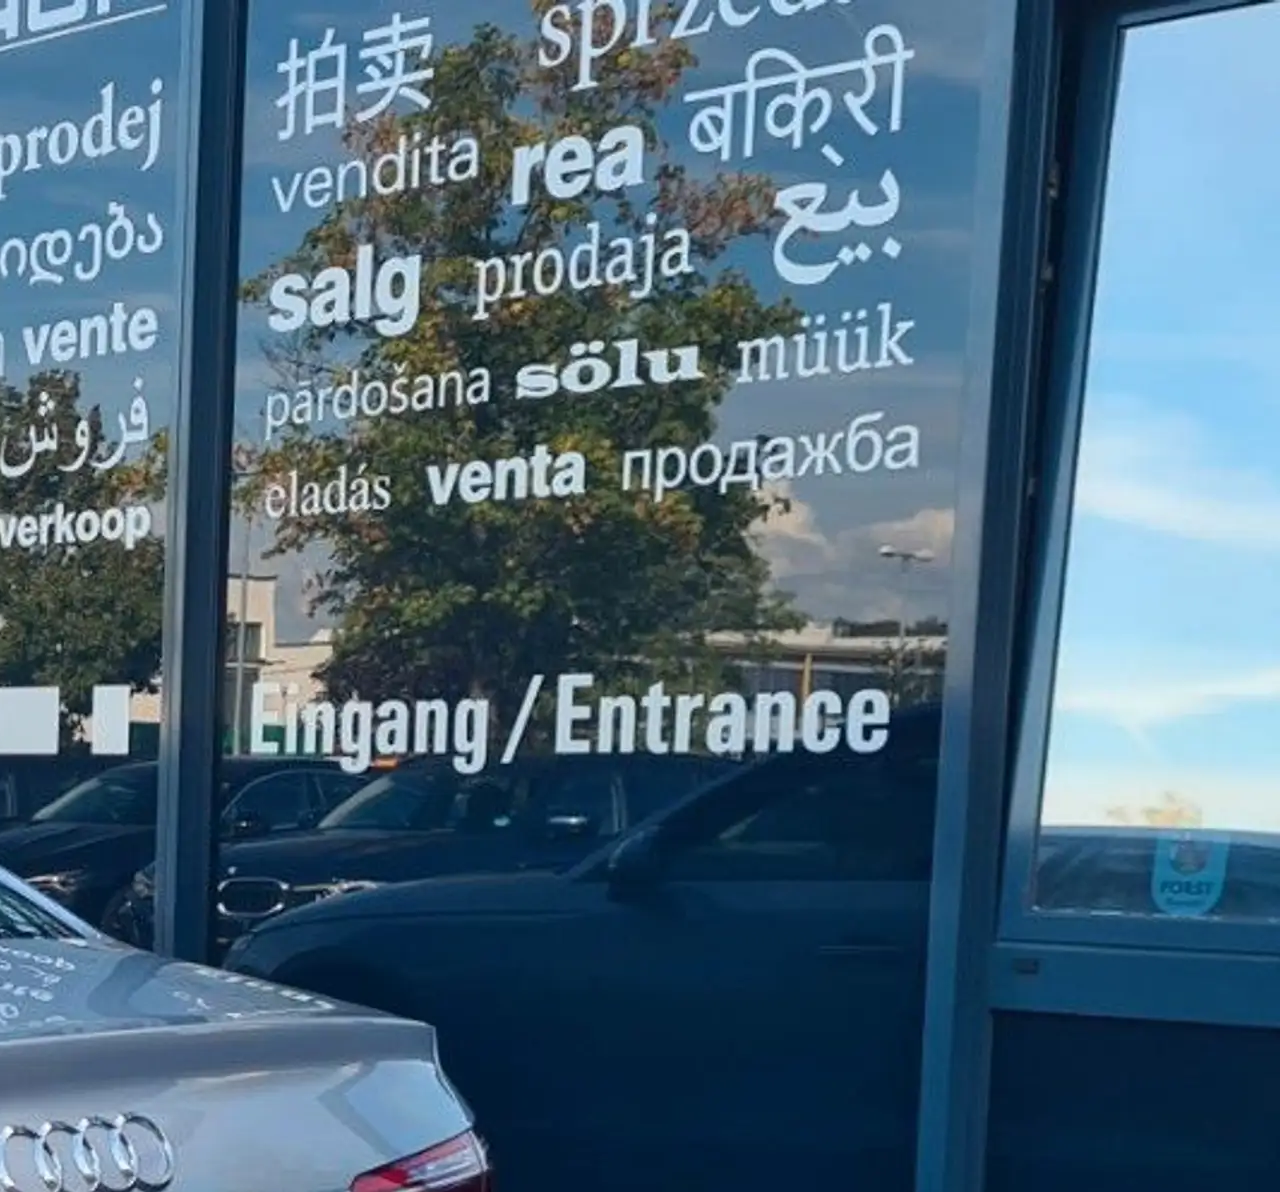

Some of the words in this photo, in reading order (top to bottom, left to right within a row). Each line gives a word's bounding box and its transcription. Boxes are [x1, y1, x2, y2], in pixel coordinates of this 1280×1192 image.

[277, 13, 433, 140] 拍卖
[272, 132, 478, 212] vendita
[511, 126, 644, 205] rea
[773, 168, 902, 285] بيع
[268, 244, 421, 336] salg
[472, 220, 694, 320] prodaja
[23, 302, 158, 365] vente
[265, 361, 490, 440] pārdošana
[515, 340, 705, 399] sölu
[738, 303, 914, 383] müük
[265, 462, 392, 519] eladás
[426, 443, 586, 504] venta
[621, 412, 921, 501] продажба
[250, 681, 489, 774] Eingang
[555, 673, 890, 755] Entrance
